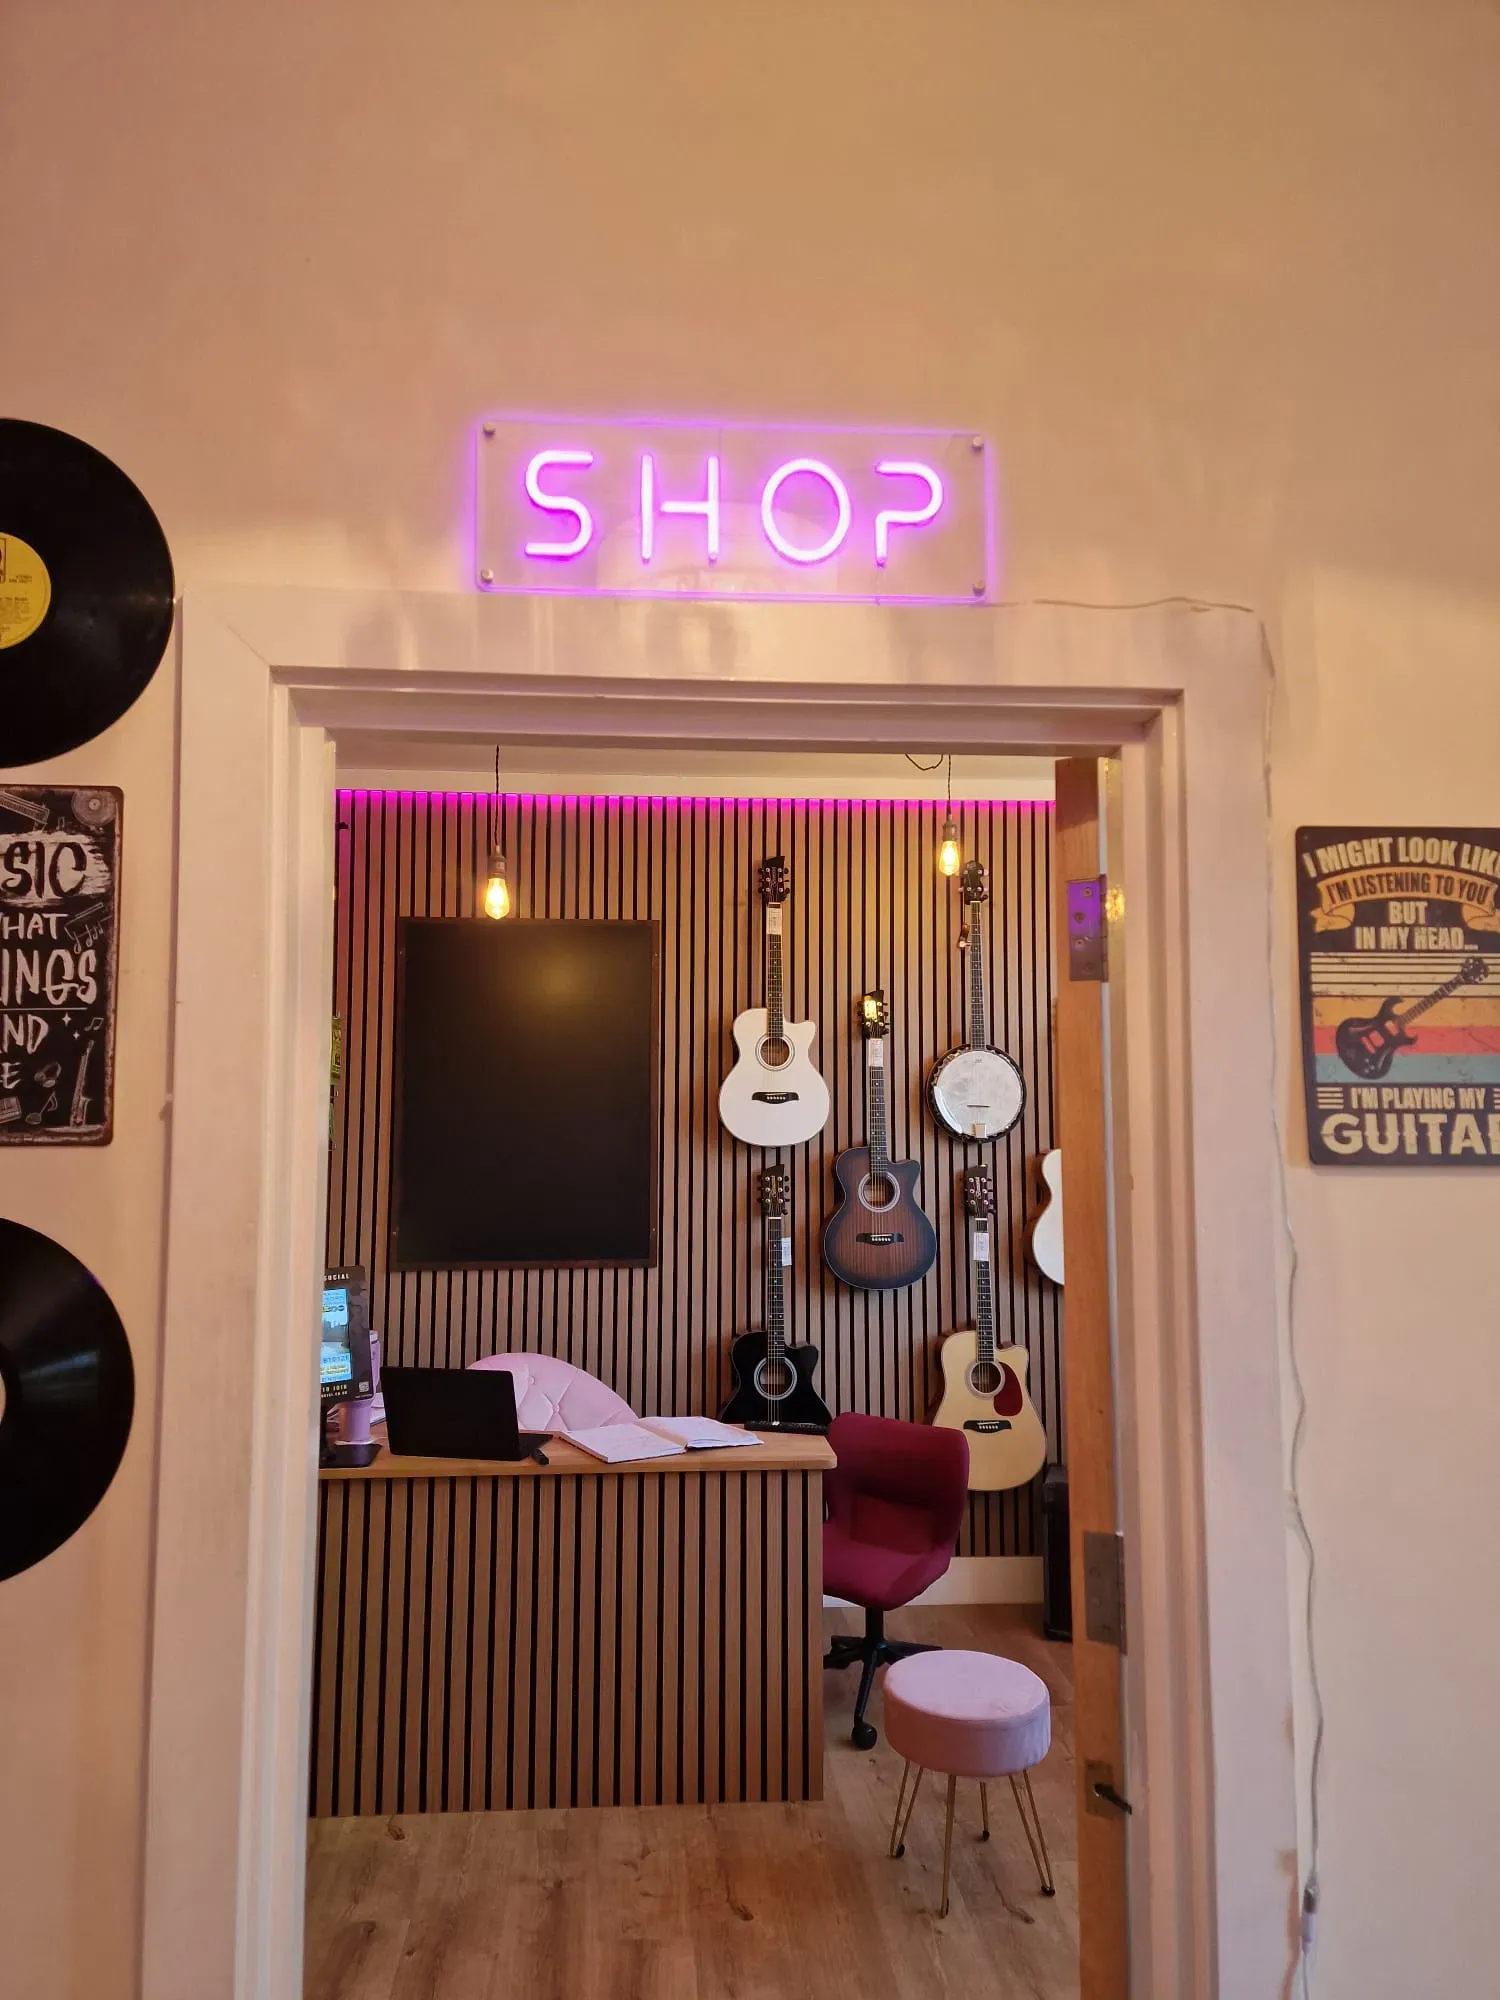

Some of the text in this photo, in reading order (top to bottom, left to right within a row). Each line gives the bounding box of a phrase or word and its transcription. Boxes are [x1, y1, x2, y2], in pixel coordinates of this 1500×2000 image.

[524, 449, 944, 567] SHOP
[1302, 852, 1317, 878] I
[1316, 837, 1393, 874] MIGHT
[1398, 836, 1457, 866] LOOK
[1326, 871, 1491, 905] I'M LISTENING TO YOU
[0, 912, 68, 940] HAT
[1389, 901, 1428, 925] BUT
[1355, 926, 1376, 950] IN
[1380, 926, 1409, 950] MY
[0, 949, 97, 1006] INGS
[0, 1013, 49, 1055] ND
[1351, 1087, 1486, 1110] I'M PLAYING MY
